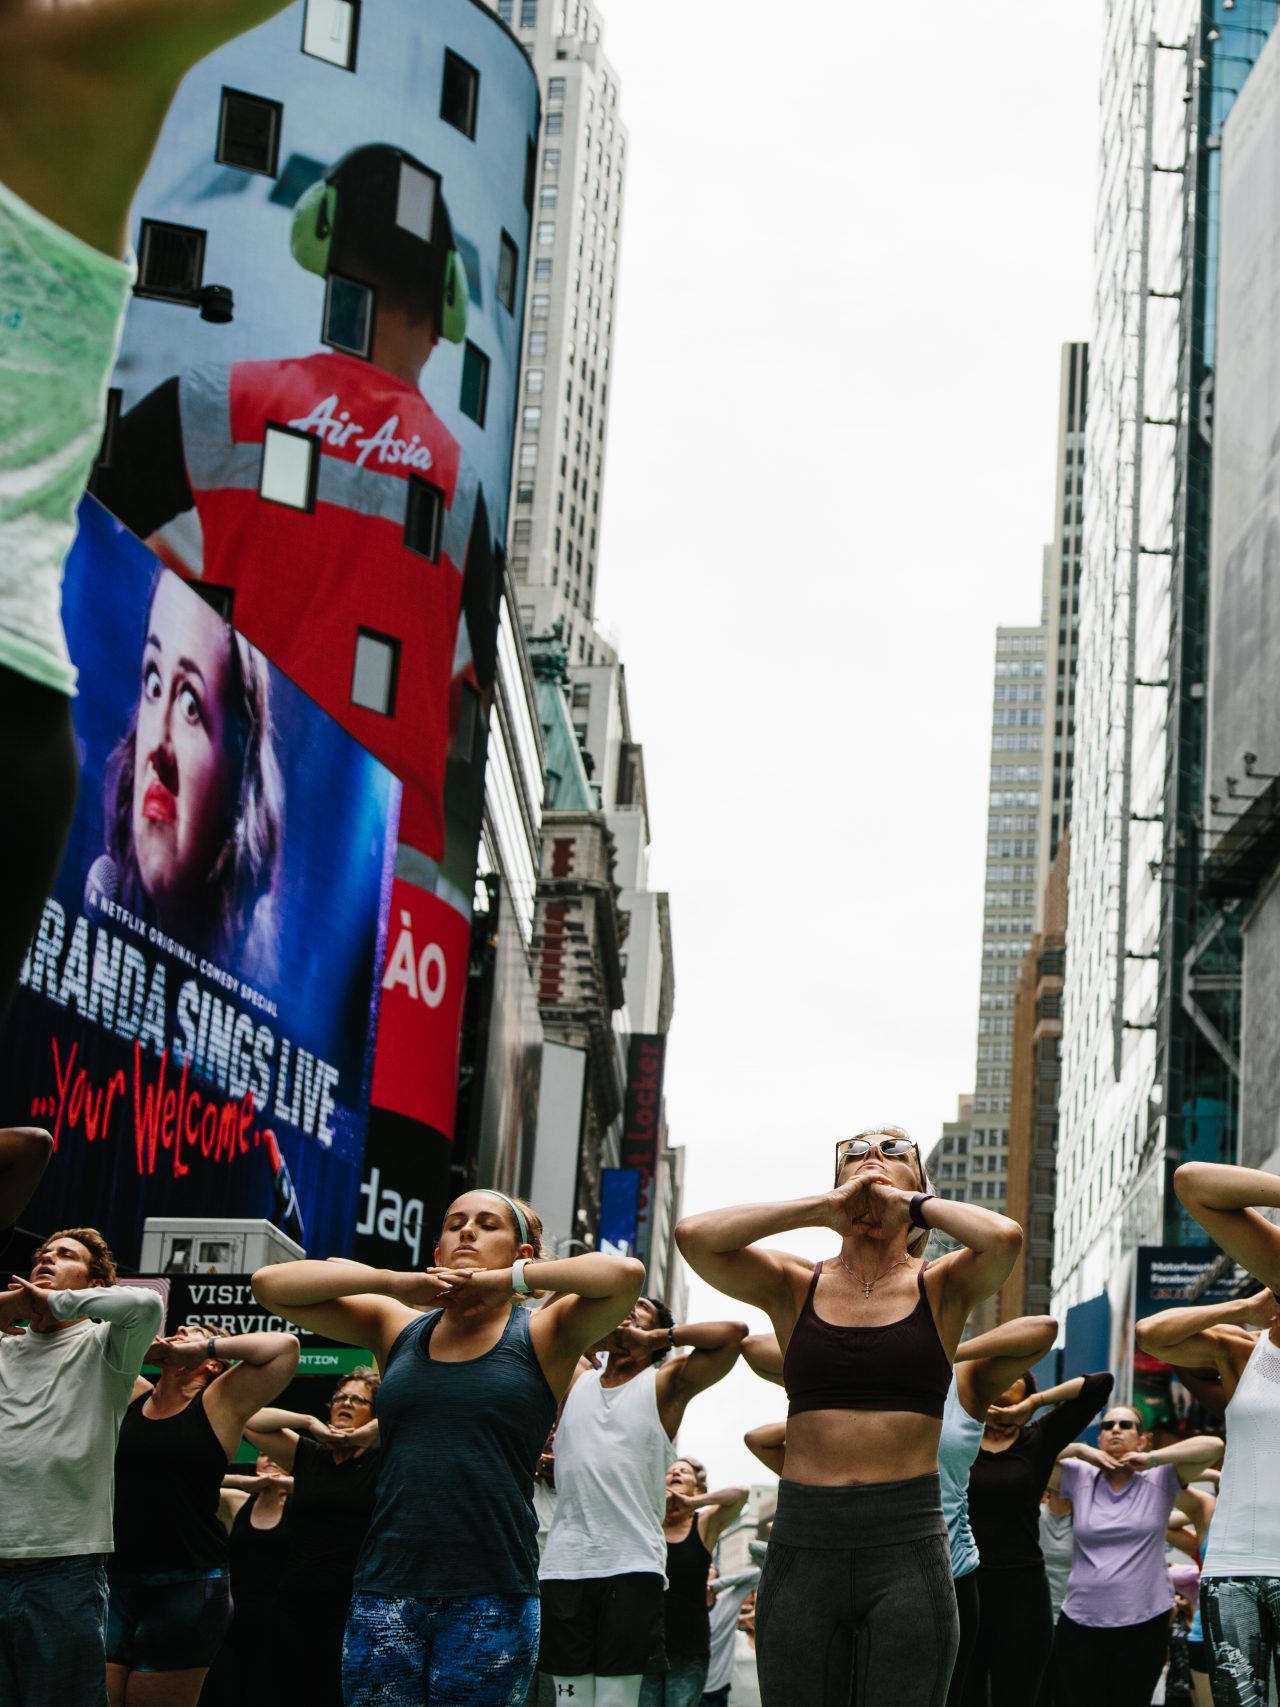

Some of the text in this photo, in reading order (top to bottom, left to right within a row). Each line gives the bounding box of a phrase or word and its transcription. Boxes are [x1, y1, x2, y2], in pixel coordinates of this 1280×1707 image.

[89, 889, 278, 1019] A NETFLIX ORIGINAL COMEDY SPECIAL
[19, 897, 340, 1148] RANDA SINGS LIVE
[627, 1041, 660, 1141] Locker
